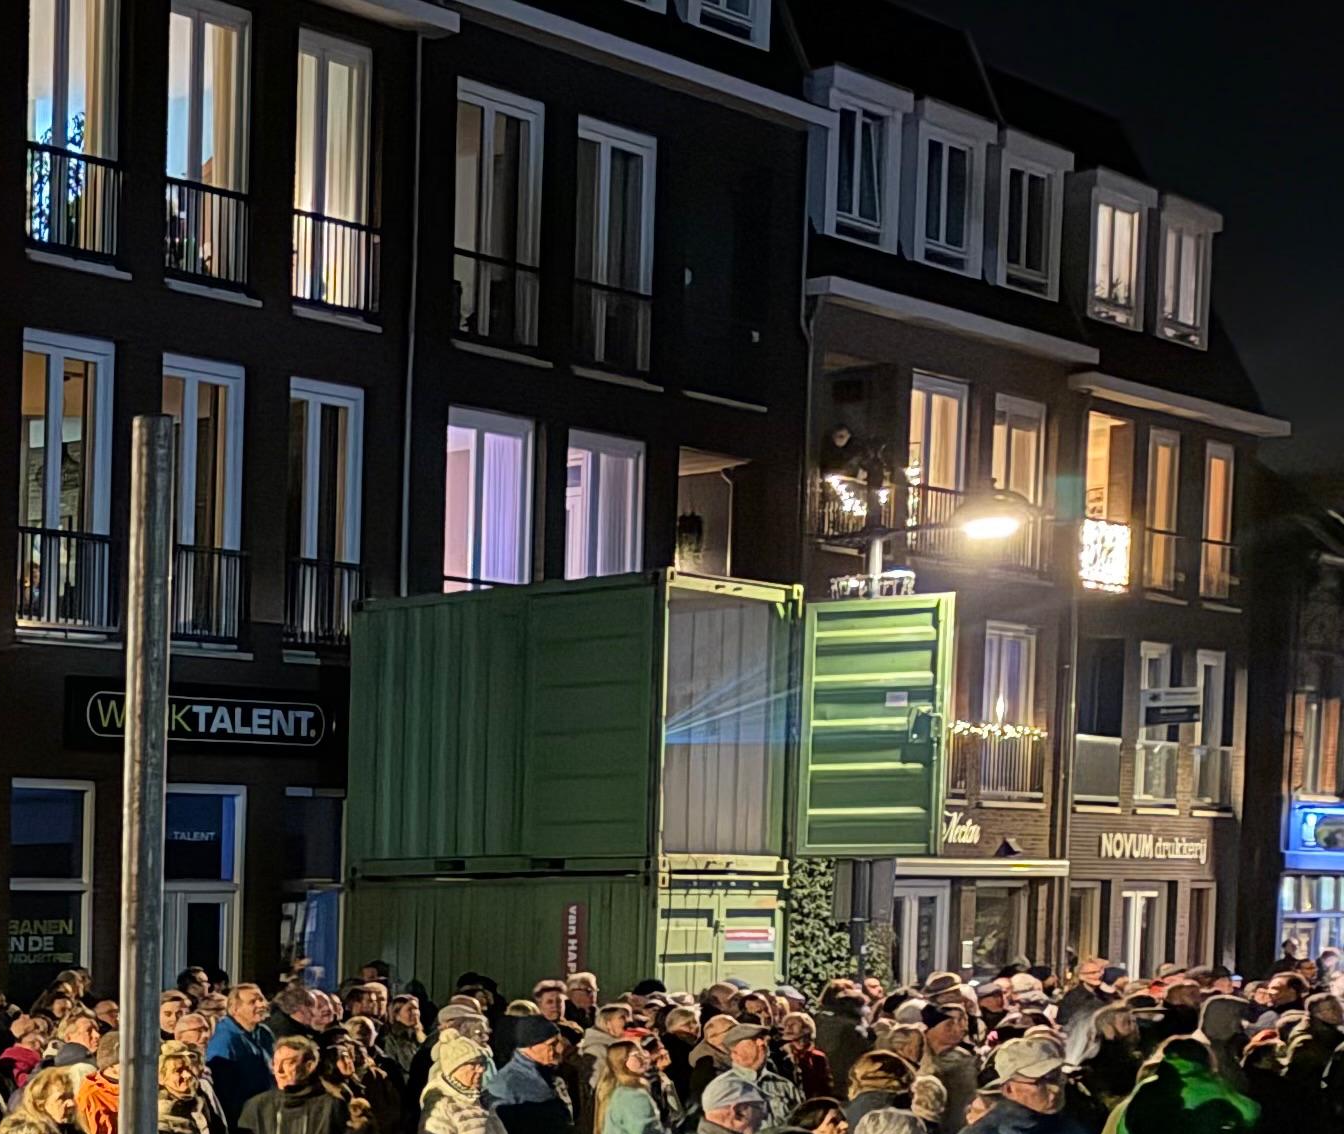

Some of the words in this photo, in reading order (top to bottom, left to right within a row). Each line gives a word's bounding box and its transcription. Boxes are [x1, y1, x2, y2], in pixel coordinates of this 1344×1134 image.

[97, 700, 316, 737] WKTALENT.
[168, 831, 216, 841] TALENT
[1101, 832, 1154, 859] NOVUM
[1155, 837, 1208, 865] drukkerij
[568, 905, 577, 936] van
[8, 952, 73, 964] NDUSTRIE
[10, 936, 25, 952] N
[28, 936, 54, 952] DE
[567, 938, 578, 973] HAP
